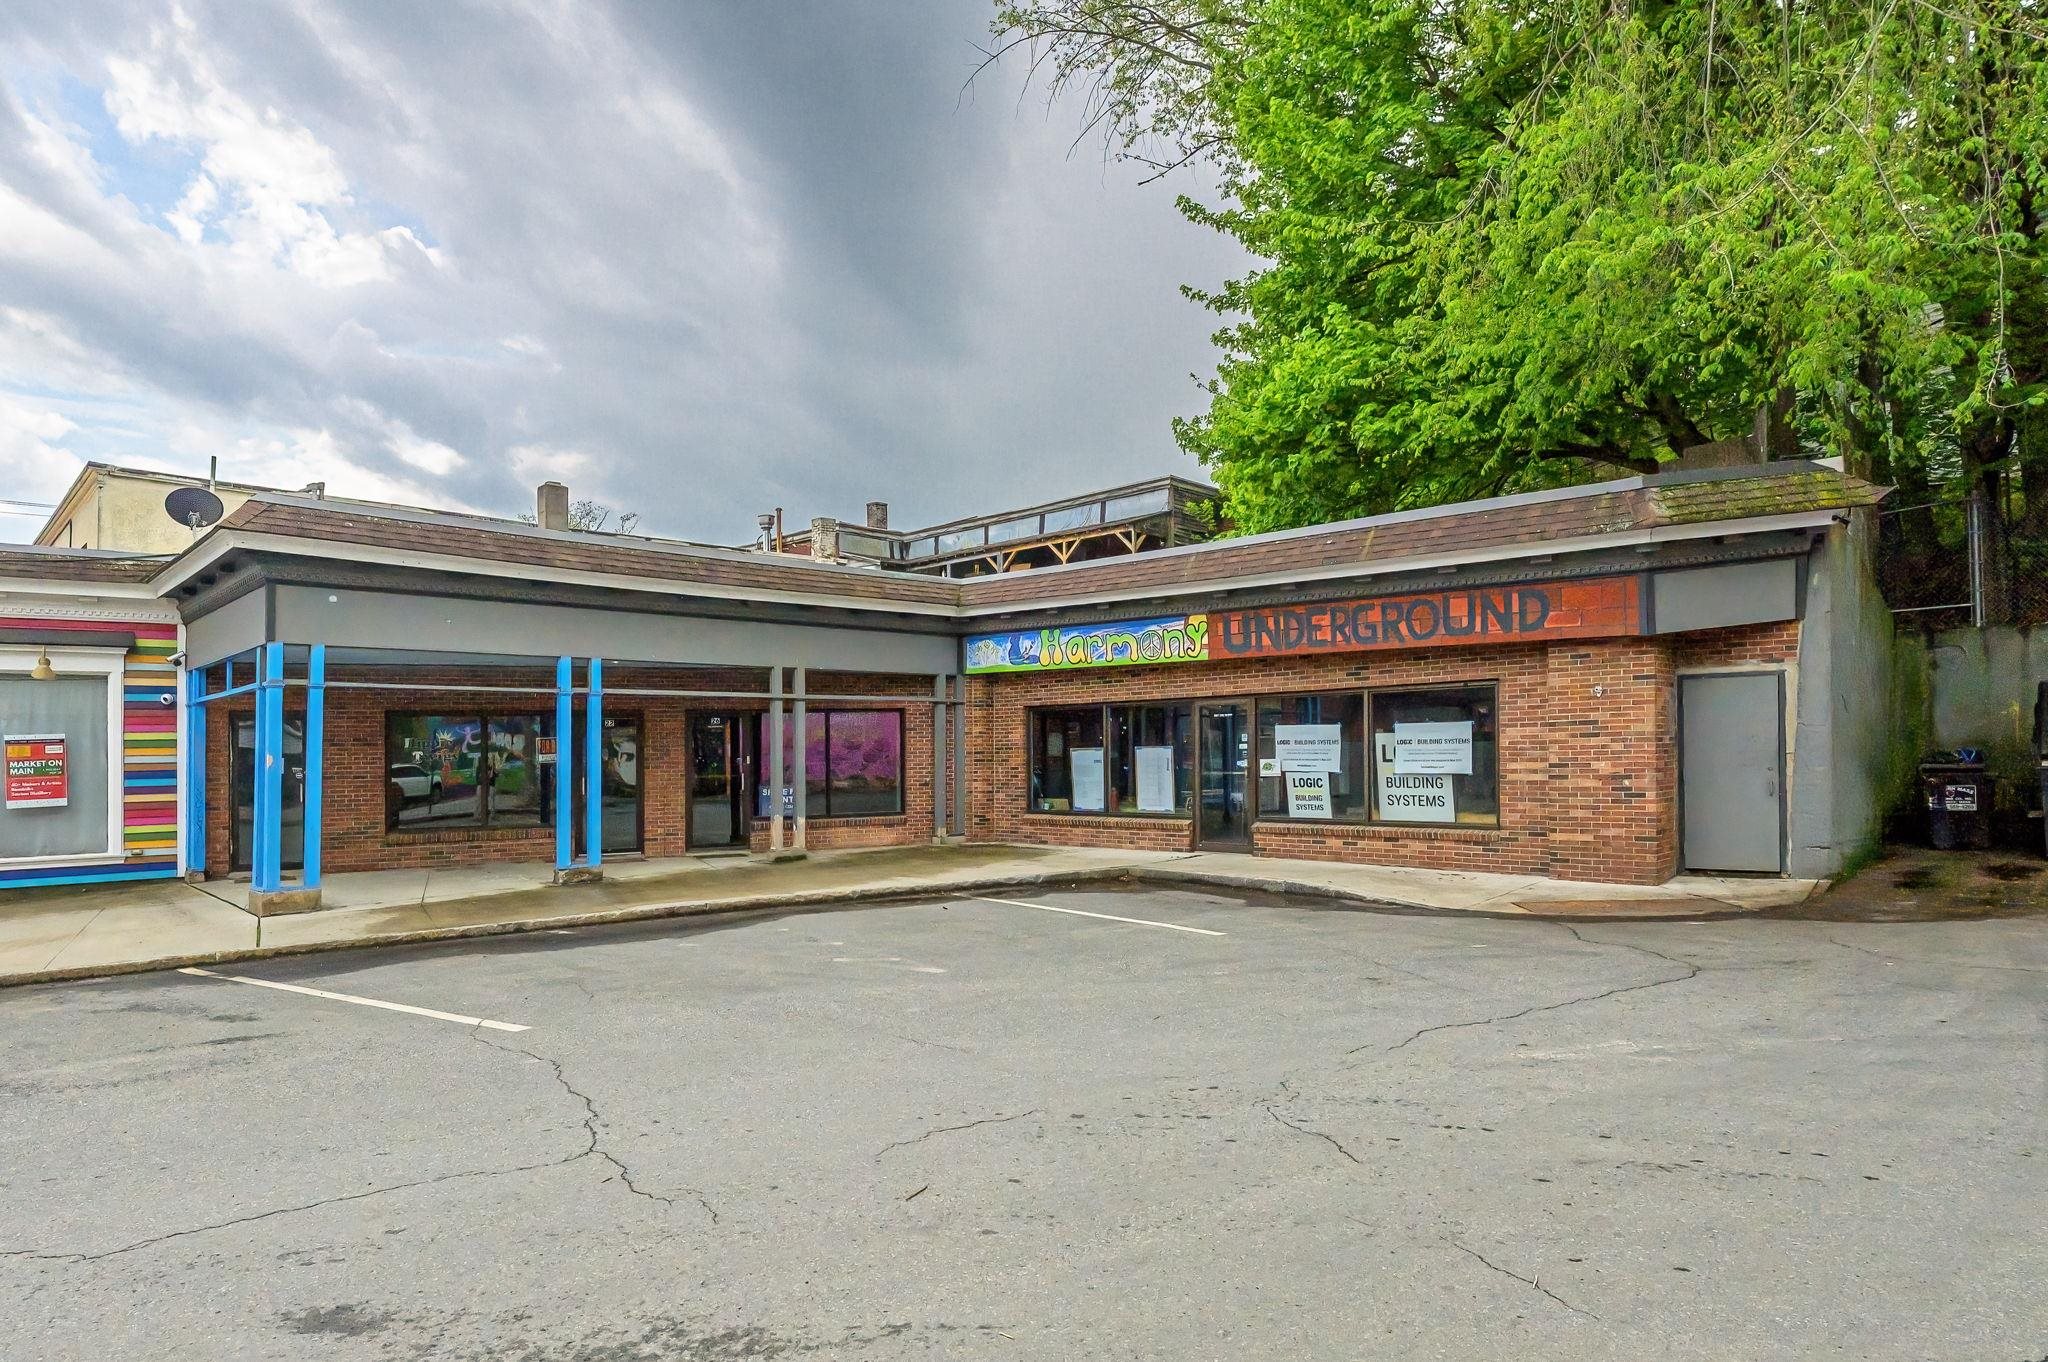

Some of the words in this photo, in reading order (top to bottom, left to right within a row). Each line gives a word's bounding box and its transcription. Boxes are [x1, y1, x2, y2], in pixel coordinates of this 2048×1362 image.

[1222, 588, 1550, 655] UNDERGROUND
[1038, 620, 1208, 667] Harmony
[1292, 778, 1323, 788] LOGIC
[1386, 776, 1444, 789] BUILDING
[1295, 794, 1323, 802] BUILDING
[1387, 794, 1445, 807] SYSTEMS
[1296, 803, 1324, 811] SYSTEMS
